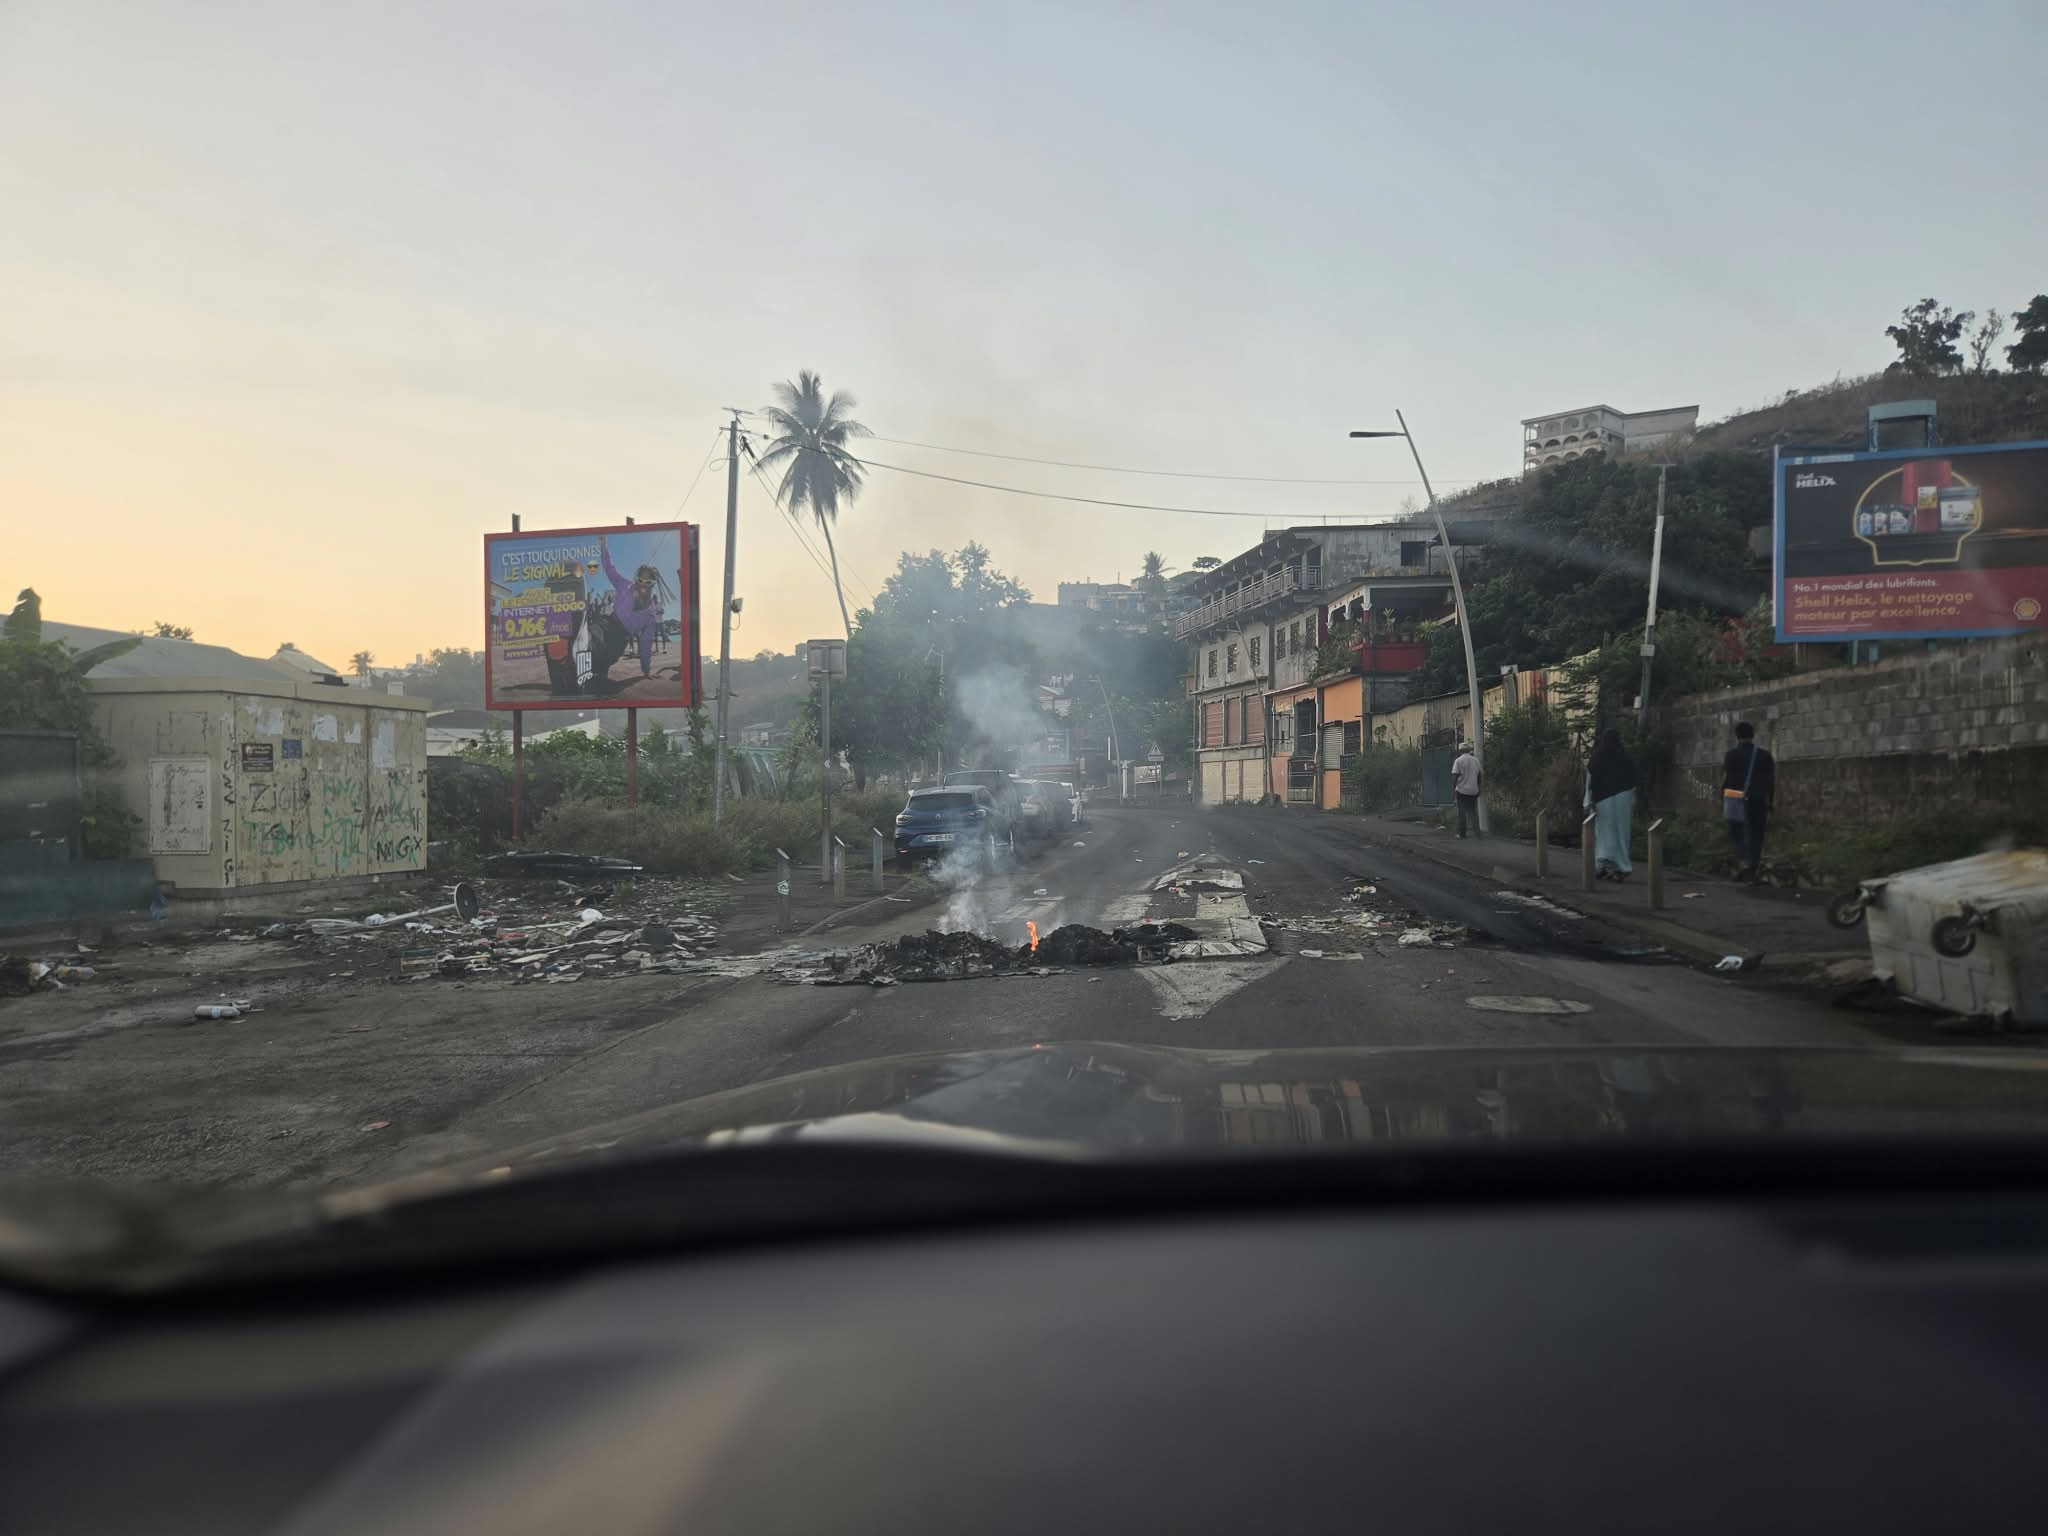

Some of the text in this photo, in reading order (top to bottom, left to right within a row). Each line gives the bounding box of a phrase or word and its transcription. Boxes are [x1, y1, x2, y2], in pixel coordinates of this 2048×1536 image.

[1796, 476, 1836, 489] HELIX
[502, 545, 601, 566] C'EST TOI QUI DONNES
[503, 562, 571, 582] LE SIGNAL
[1822, 579, 1863, 591] mondial
[1865, 579, 1883, 589] des
[1794, 593, 1830, 609] Shell
[1880, 592, 1893, 605] le
[1898, 592, 1974, 606] nettoyage
[503, 605, 550, 617] INTERNET
[1794, 606, 1961, 622] moteur par excellence.
[504, 617, 547, 638] 9.76€
